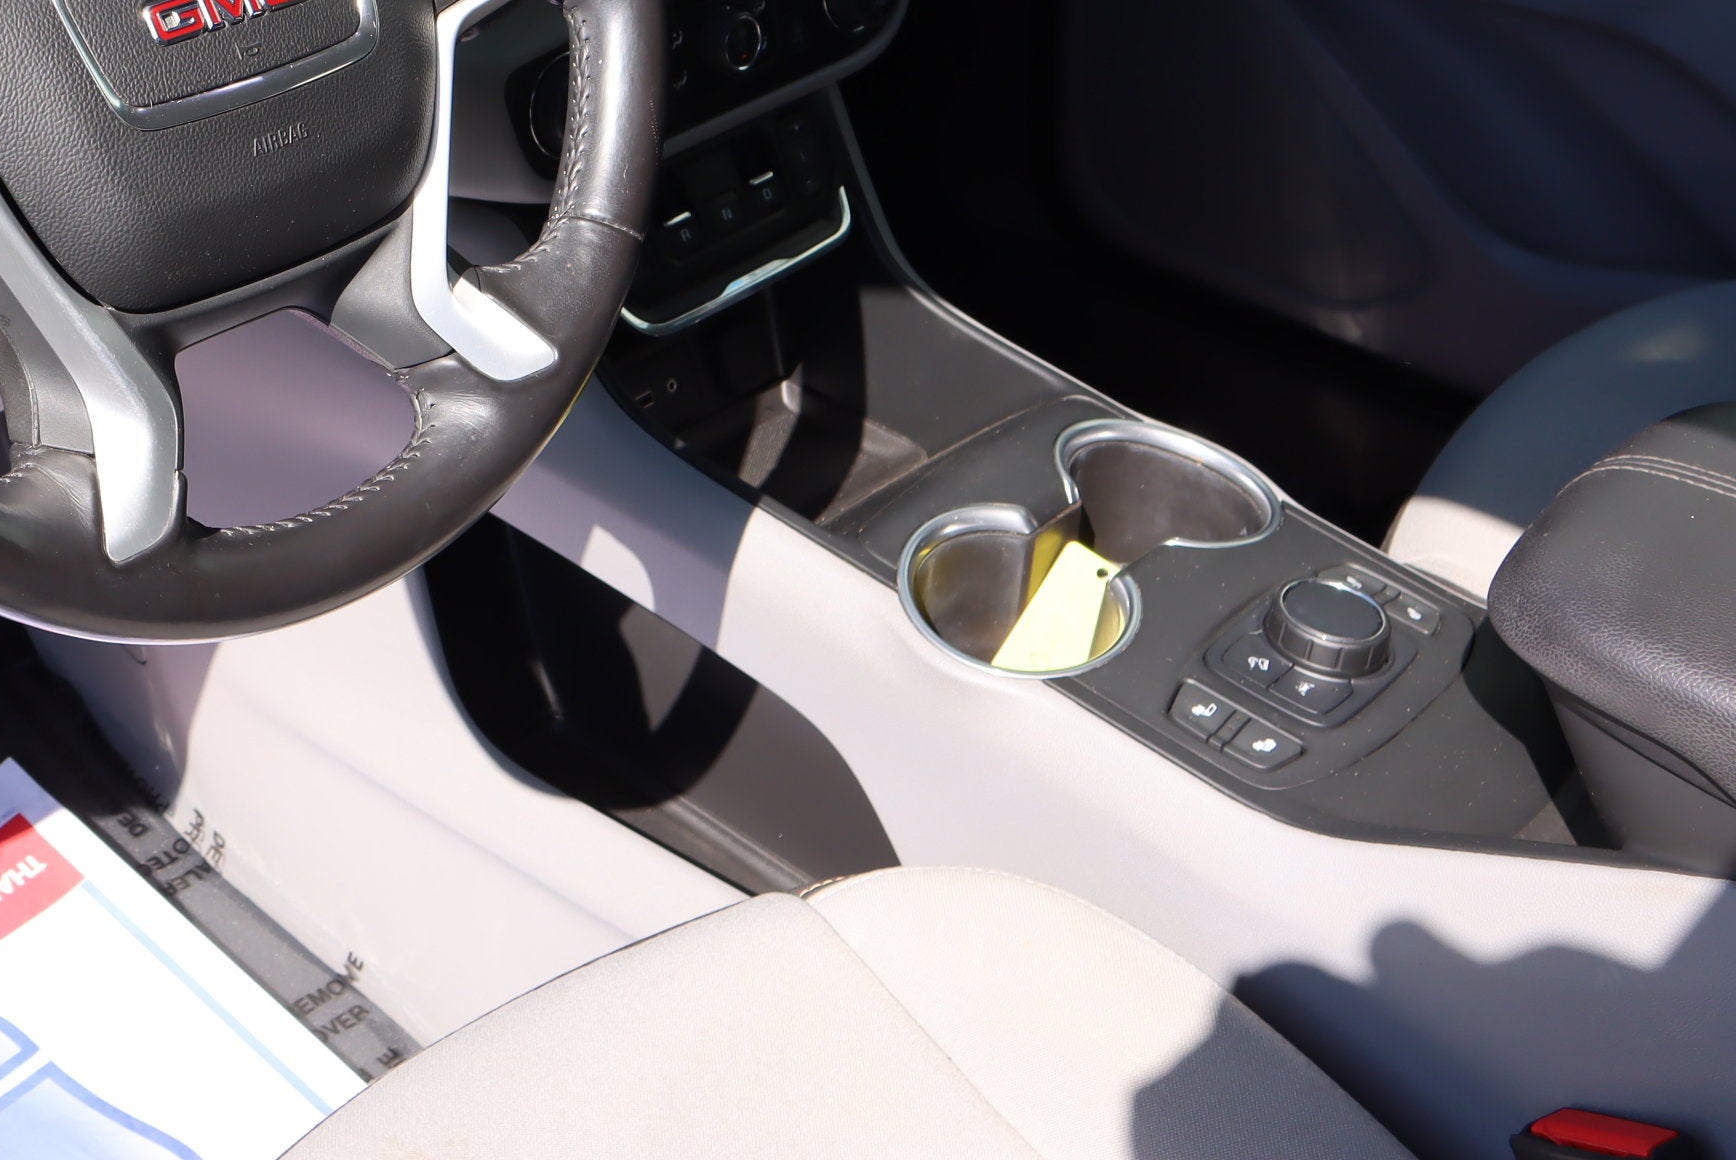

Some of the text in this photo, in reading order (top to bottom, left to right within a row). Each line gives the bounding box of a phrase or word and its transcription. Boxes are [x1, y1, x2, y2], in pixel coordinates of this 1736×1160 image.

[253, 121, 309, 157] AIRBAG
[722, 206, 733, 222] N
[680, 227, 692, 243] R
[289, 951, 365, 1019] EMOVE
